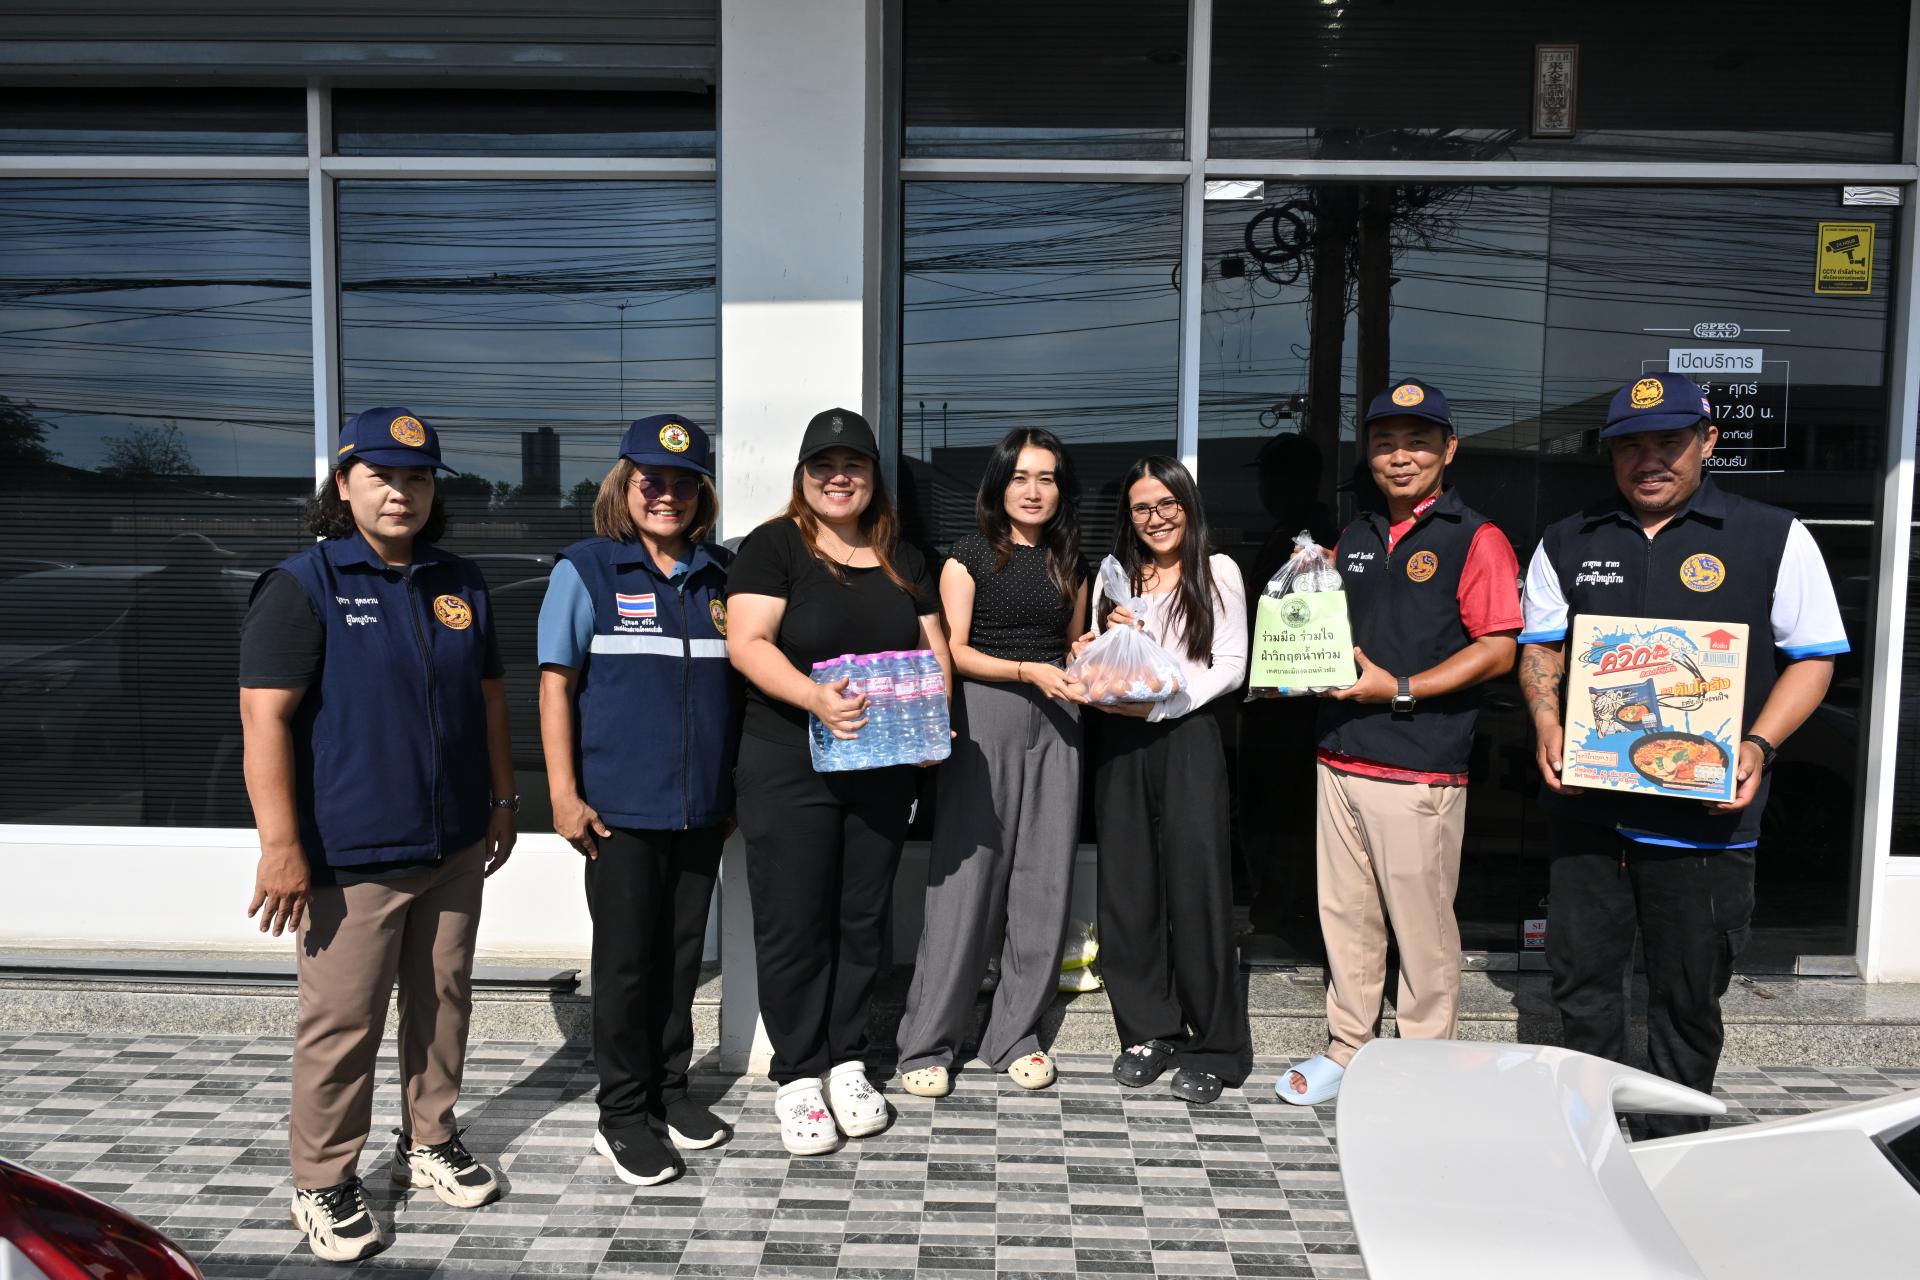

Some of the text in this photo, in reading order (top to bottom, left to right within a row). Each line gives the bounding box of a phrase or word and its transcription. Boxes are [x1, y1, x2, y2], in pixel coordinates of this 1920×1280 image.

[1701, 322, 1733, 330] SPEC
[1676, 353, 1754, 369] เปิดบริการ
[1729, 381, 1758, 399] ศุกร์
[1715, 404, 1774, 419] 17.30 น.
[1722, 430, 1753, 439] อาทิตย์
[1262, 627, 1334, 642] ร่วมมือ ร่วมใจ
[1261, 646, 1341, 663] ฝ่าวิกฤตน้ำท่วม
[1600, 644, 1651, 671] ควิก
